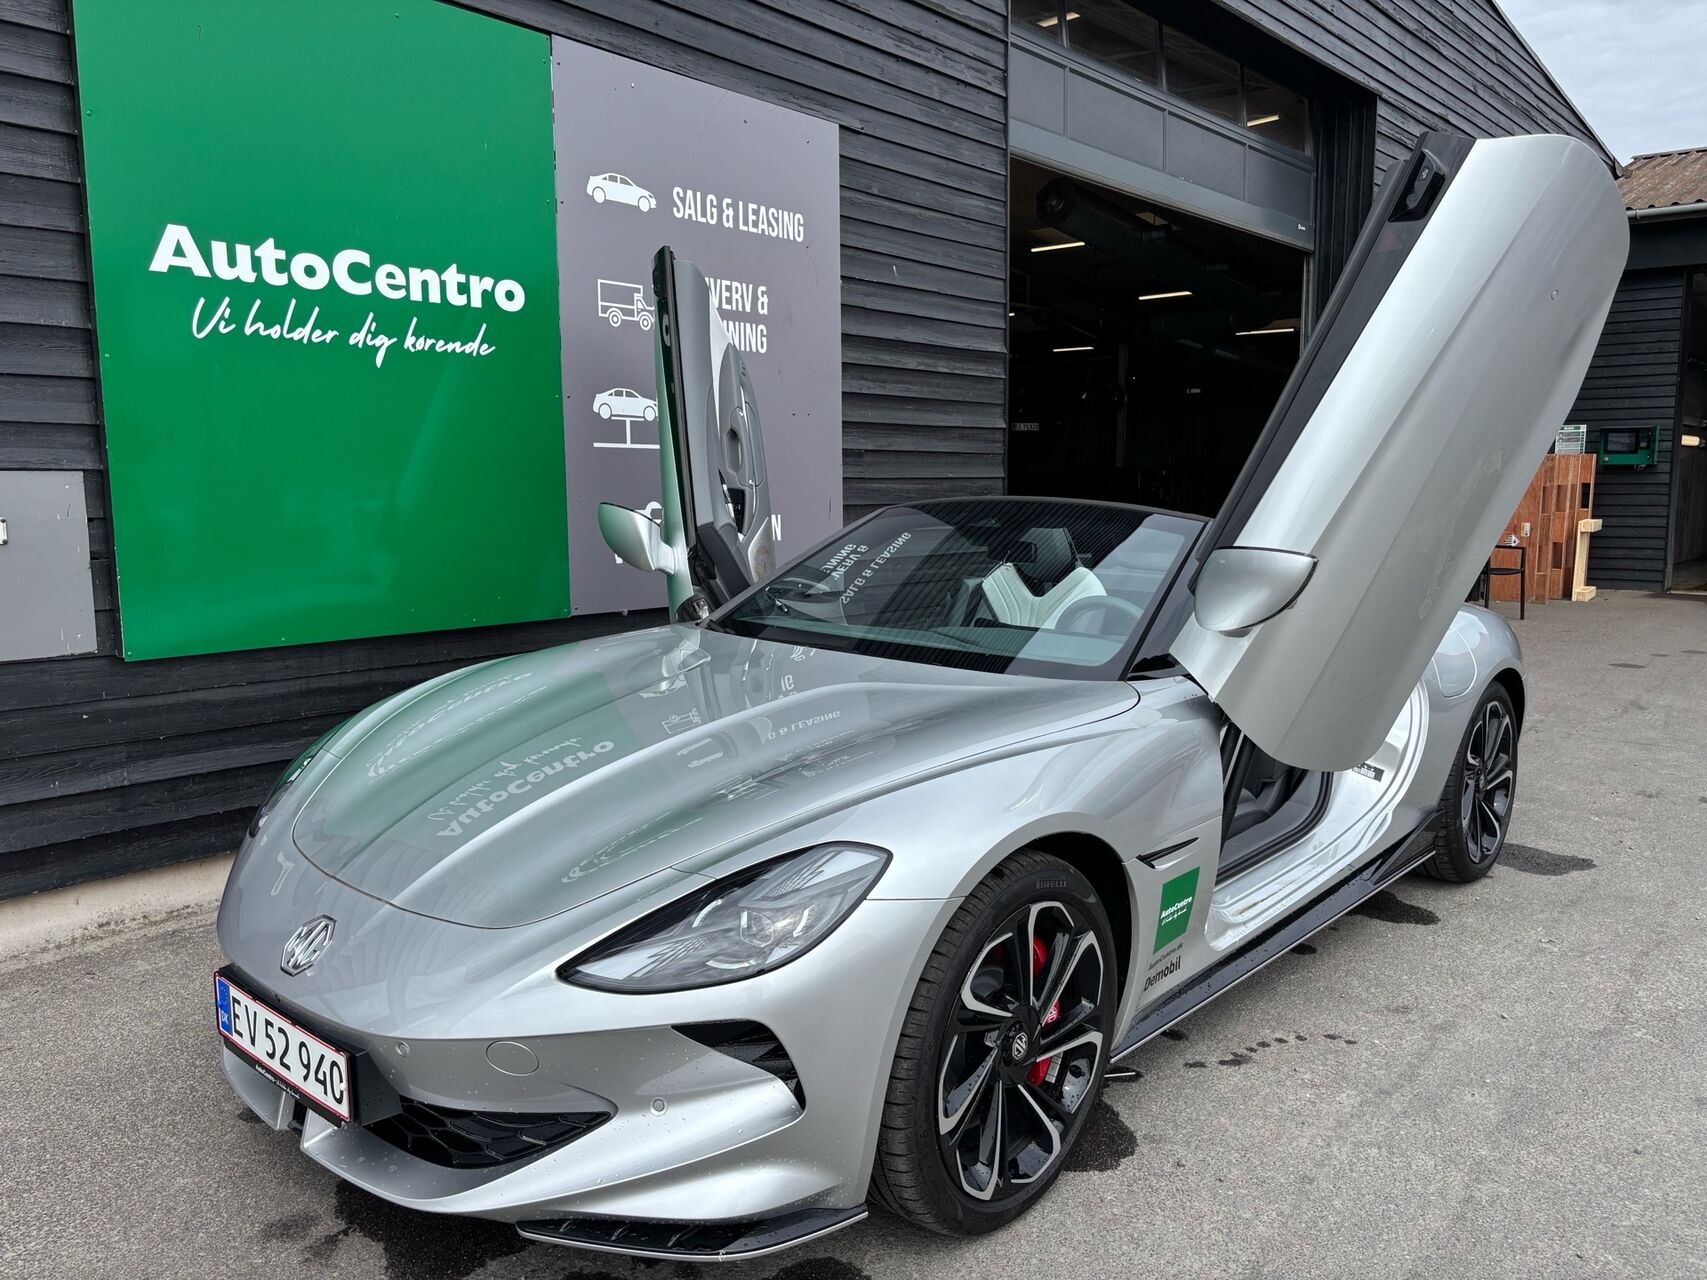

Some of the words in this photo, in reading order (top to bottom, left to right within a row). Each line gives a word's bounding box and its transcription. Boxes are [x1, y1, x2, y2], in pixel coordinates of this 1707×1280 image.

[672, 186, 718, 225] SALG
[722, 197, 734, 229] &
[738, 200, 804, 242] LEASING
[148, 223, 526, 313] AutoCentro
[704, 276, 753, 313] VERV
[757, 285, 768, 315] &
[192, 296, 236, 339] Vi
[244, 297, 340, 345] holder
[349, 311, 397, 368] dig
[403, 316, 496, 357] kørende
[722, 319, 768, 354] NING
[283, 917, 335, 972] MG
[1143, 955, 1181, 992] Demobil
[231, 995, 257, 1047] EV
[264, 1017, 291, 1072] 52
[298, 1041, 344, 1105] 940
